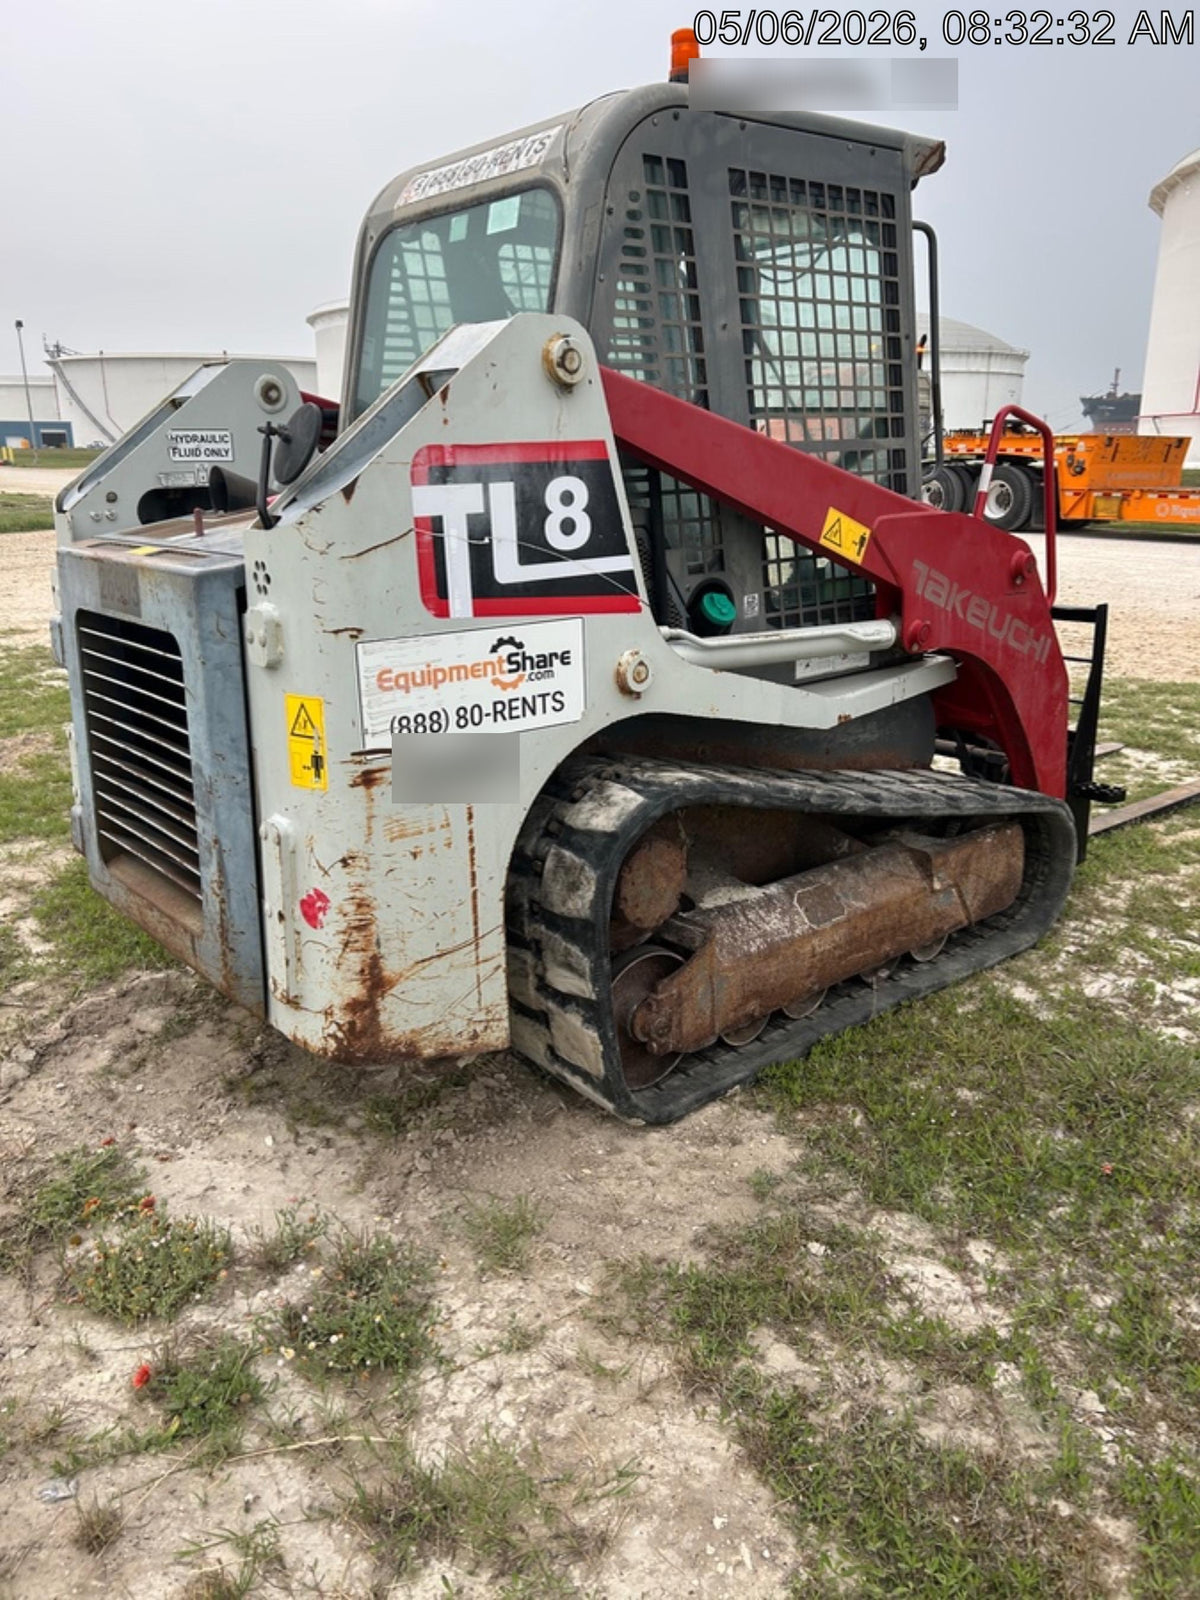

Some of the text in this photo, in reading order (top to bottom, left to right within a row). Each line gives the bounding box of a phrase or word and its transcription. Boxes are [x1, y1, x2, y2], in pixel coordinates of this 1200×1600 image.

[170, 433, 229, 443] HYDRAULIC
[172, 447, 229, 457] FLUID ONLY
[411, 475, 634, 617] TL8
[376, 650, 571, 693] EquipmentShare
[526, 669, 554, 682] .com
[456, 691, 565, 729] 80-RENTS
